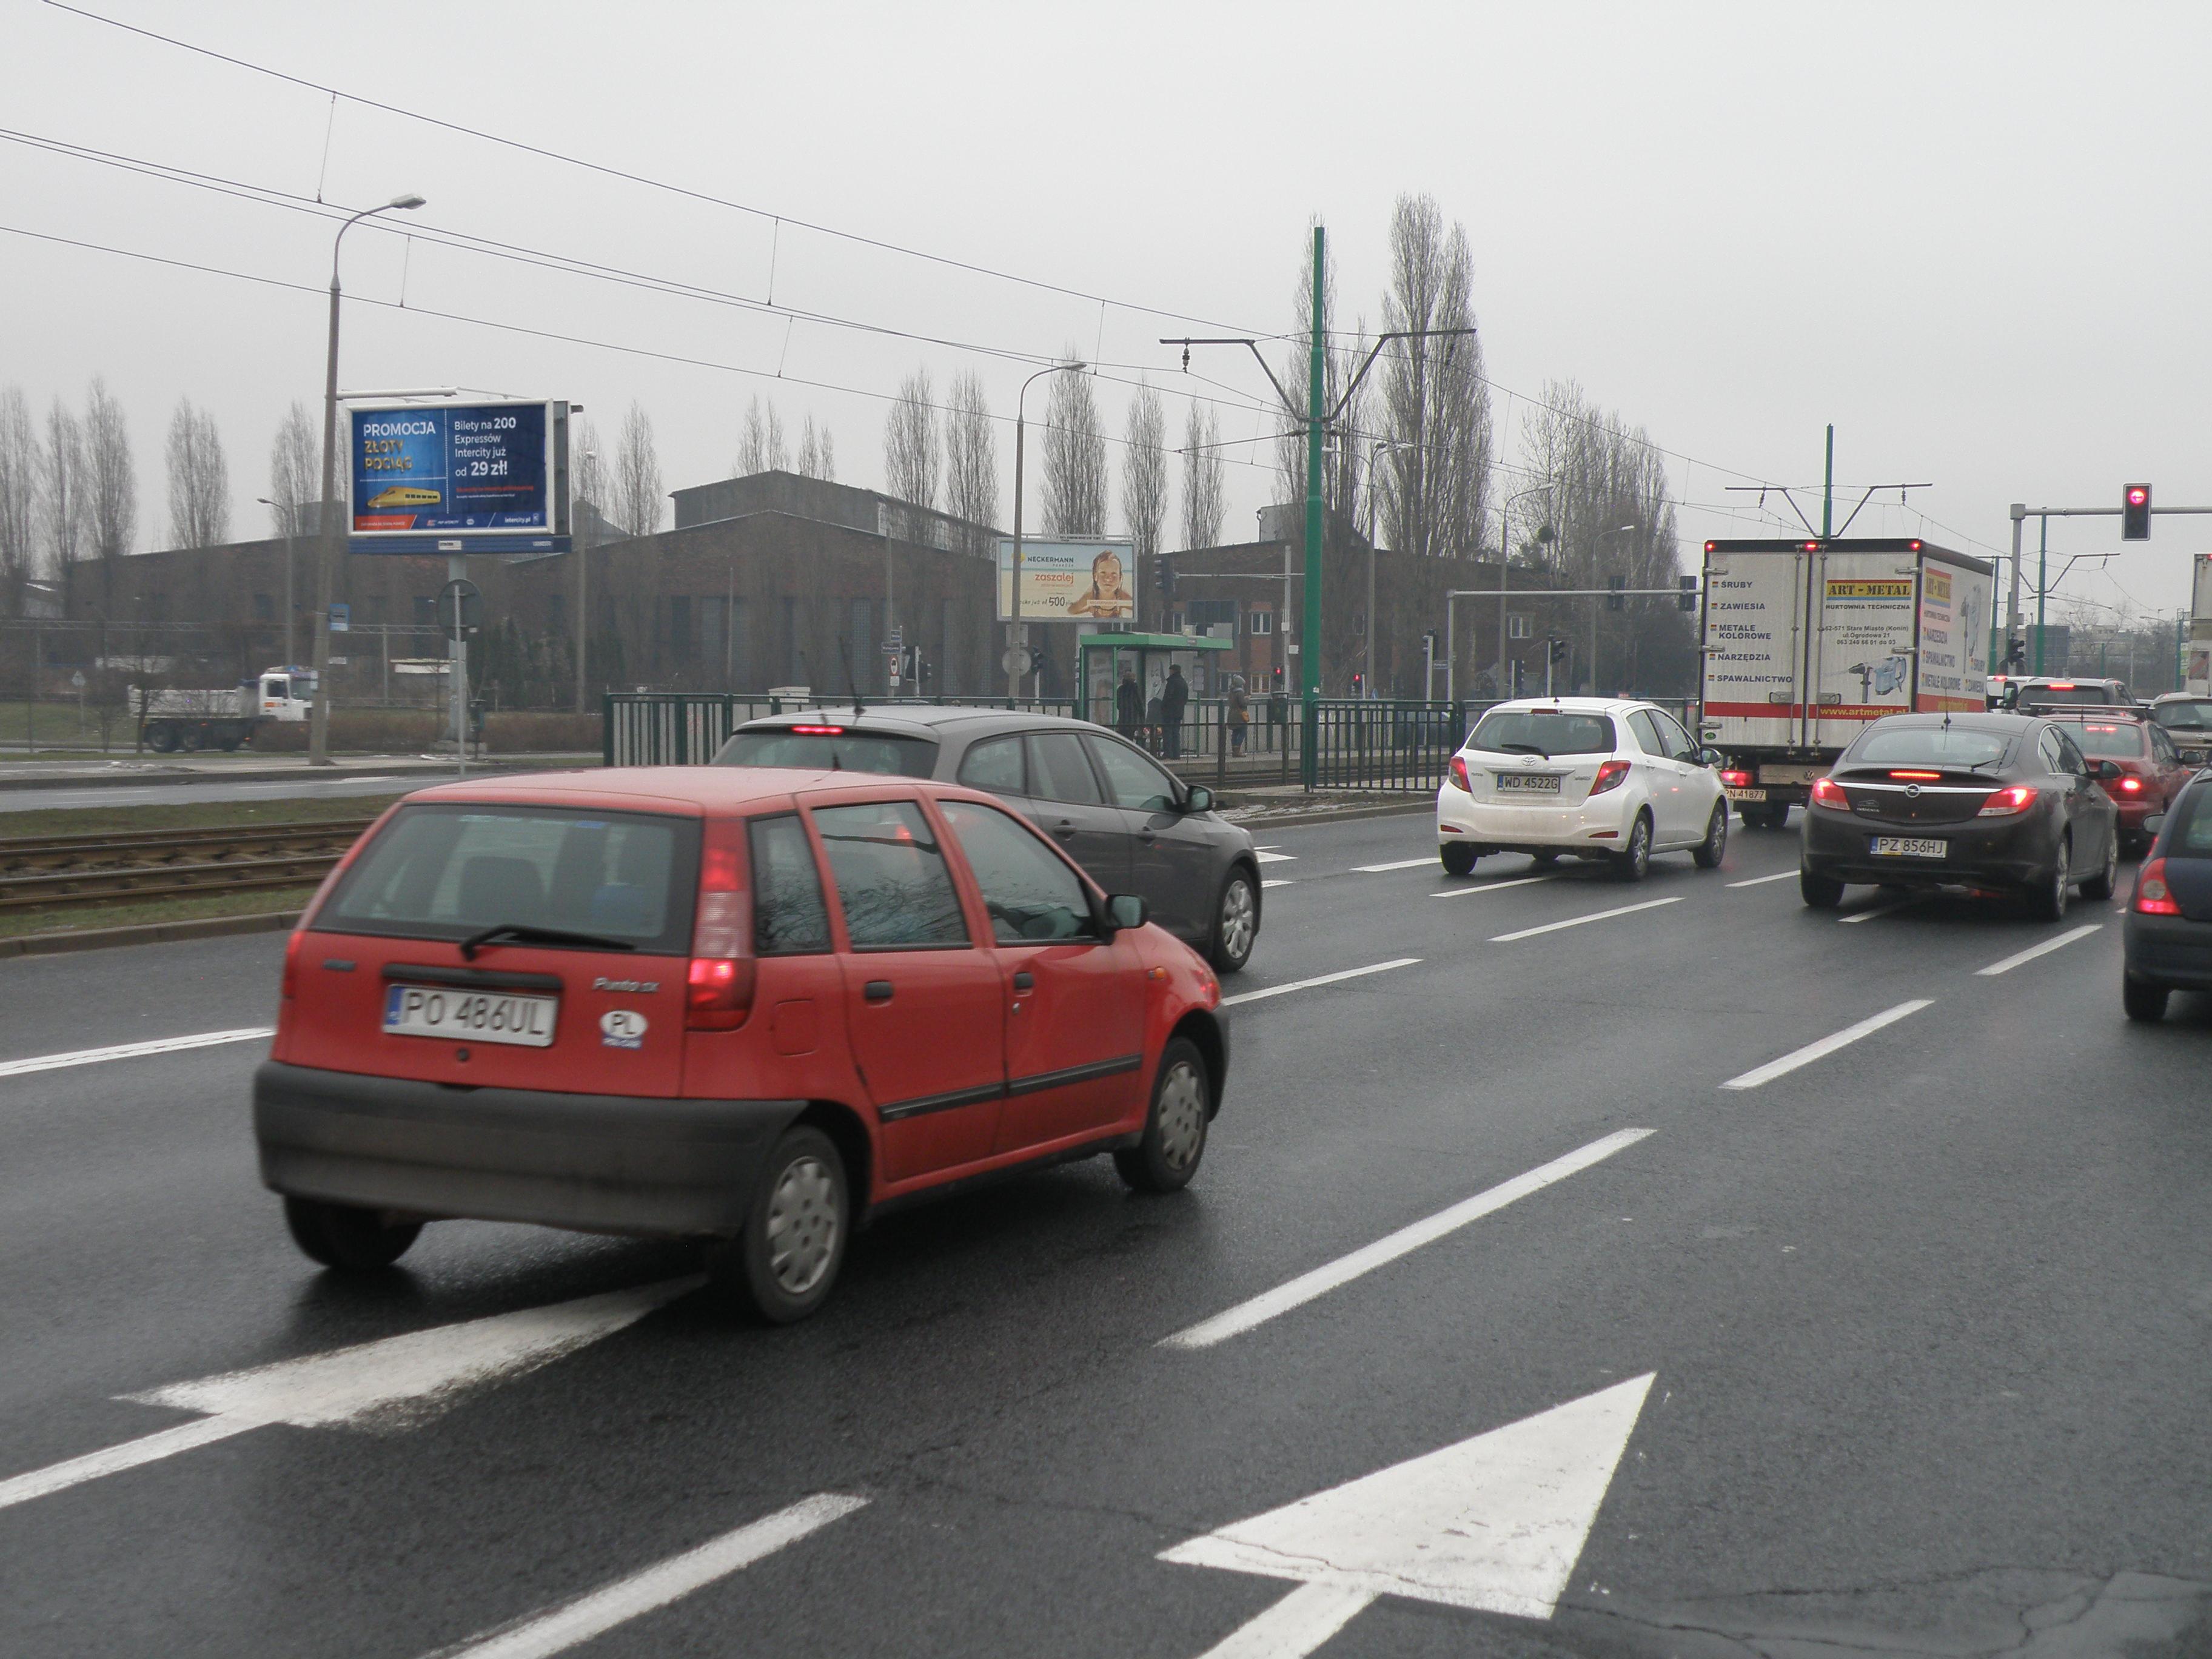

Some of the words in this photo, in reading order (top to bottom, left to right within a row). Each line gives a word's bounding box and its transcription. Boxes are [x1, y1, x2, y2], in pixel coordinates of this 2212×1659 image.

[363, 421, 436, 437] PROMOCJA
[454, 420, 479, 432] Bilety
[481, 421, 492, 430] na
[494, 417, 516, 429] 200
[455, 433, 501, 446] Expressów
[364, 439, 404, 454] ZŁOTY
[455, 447, 491, 458] Intercity
[492, 446, 506, 458] już
[365, 456, 413, 473] POCIĄG
[455, 466, 467, 476] od
[471, 461, 488, 476] 29
[491, 460, 508, 475] zł!
[1035, 572, 1074, 585] zaszalej
[1721, 580, 1752, 588] ŚRUBY
[1829, 585, 1855, 595] ART
[1866, 585, 1910, 595] METAL
[1048, 596, 1065, 607] 500
[1718, 654, 1771, 663] NARZĘDZIA
[1717, 674, 1792, 683] SPAWALNICTWO
[1505, 777, 1520, 788] WD
[1524, 778, 1558, 789] 4522G
[1738, 789, 1765, 799] 41877
[1879, 839, 1899, 851] PZ
[1903, 840, 1943, 854] 856HJ
[403, 991, 446, 1025] PO
[454, 996, 545, 1035] 486UL
[610, 1013, 637, 1036] PL
